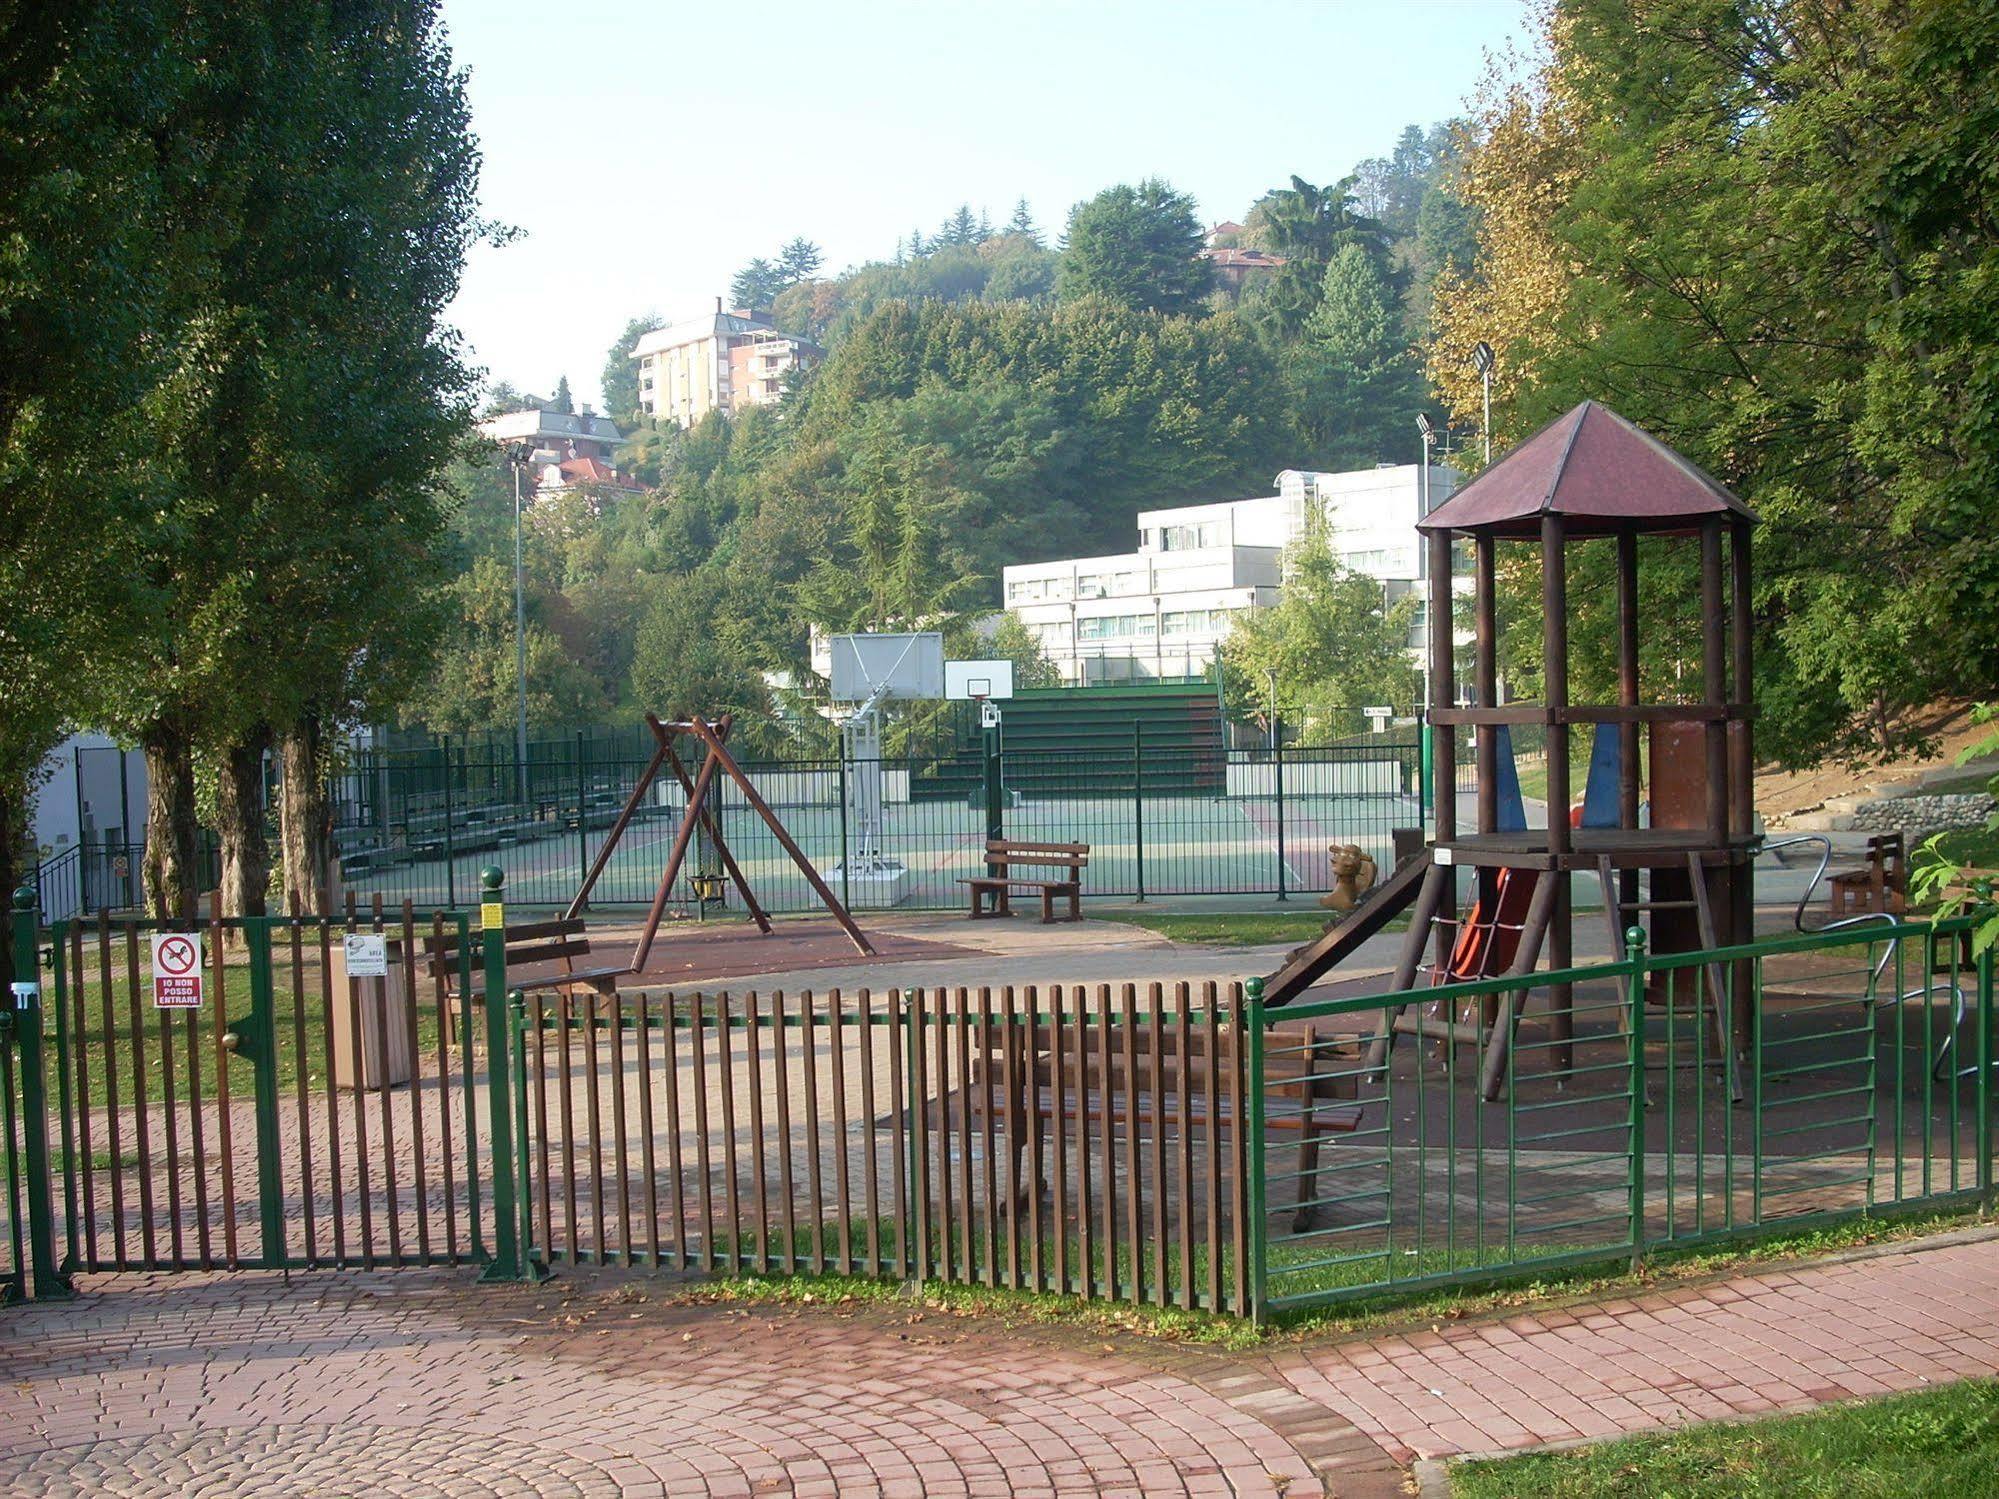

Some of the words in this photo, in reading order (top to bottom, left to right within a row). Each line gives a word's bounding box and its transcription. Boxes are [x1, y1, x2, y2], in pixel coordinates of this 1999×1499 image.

[163, 979, 173, 987] IO
[175, 979, 193, 987] NON
[164, 987, 193, 995] POSSO
[159, 996, 198, 1004] ENTRARE
